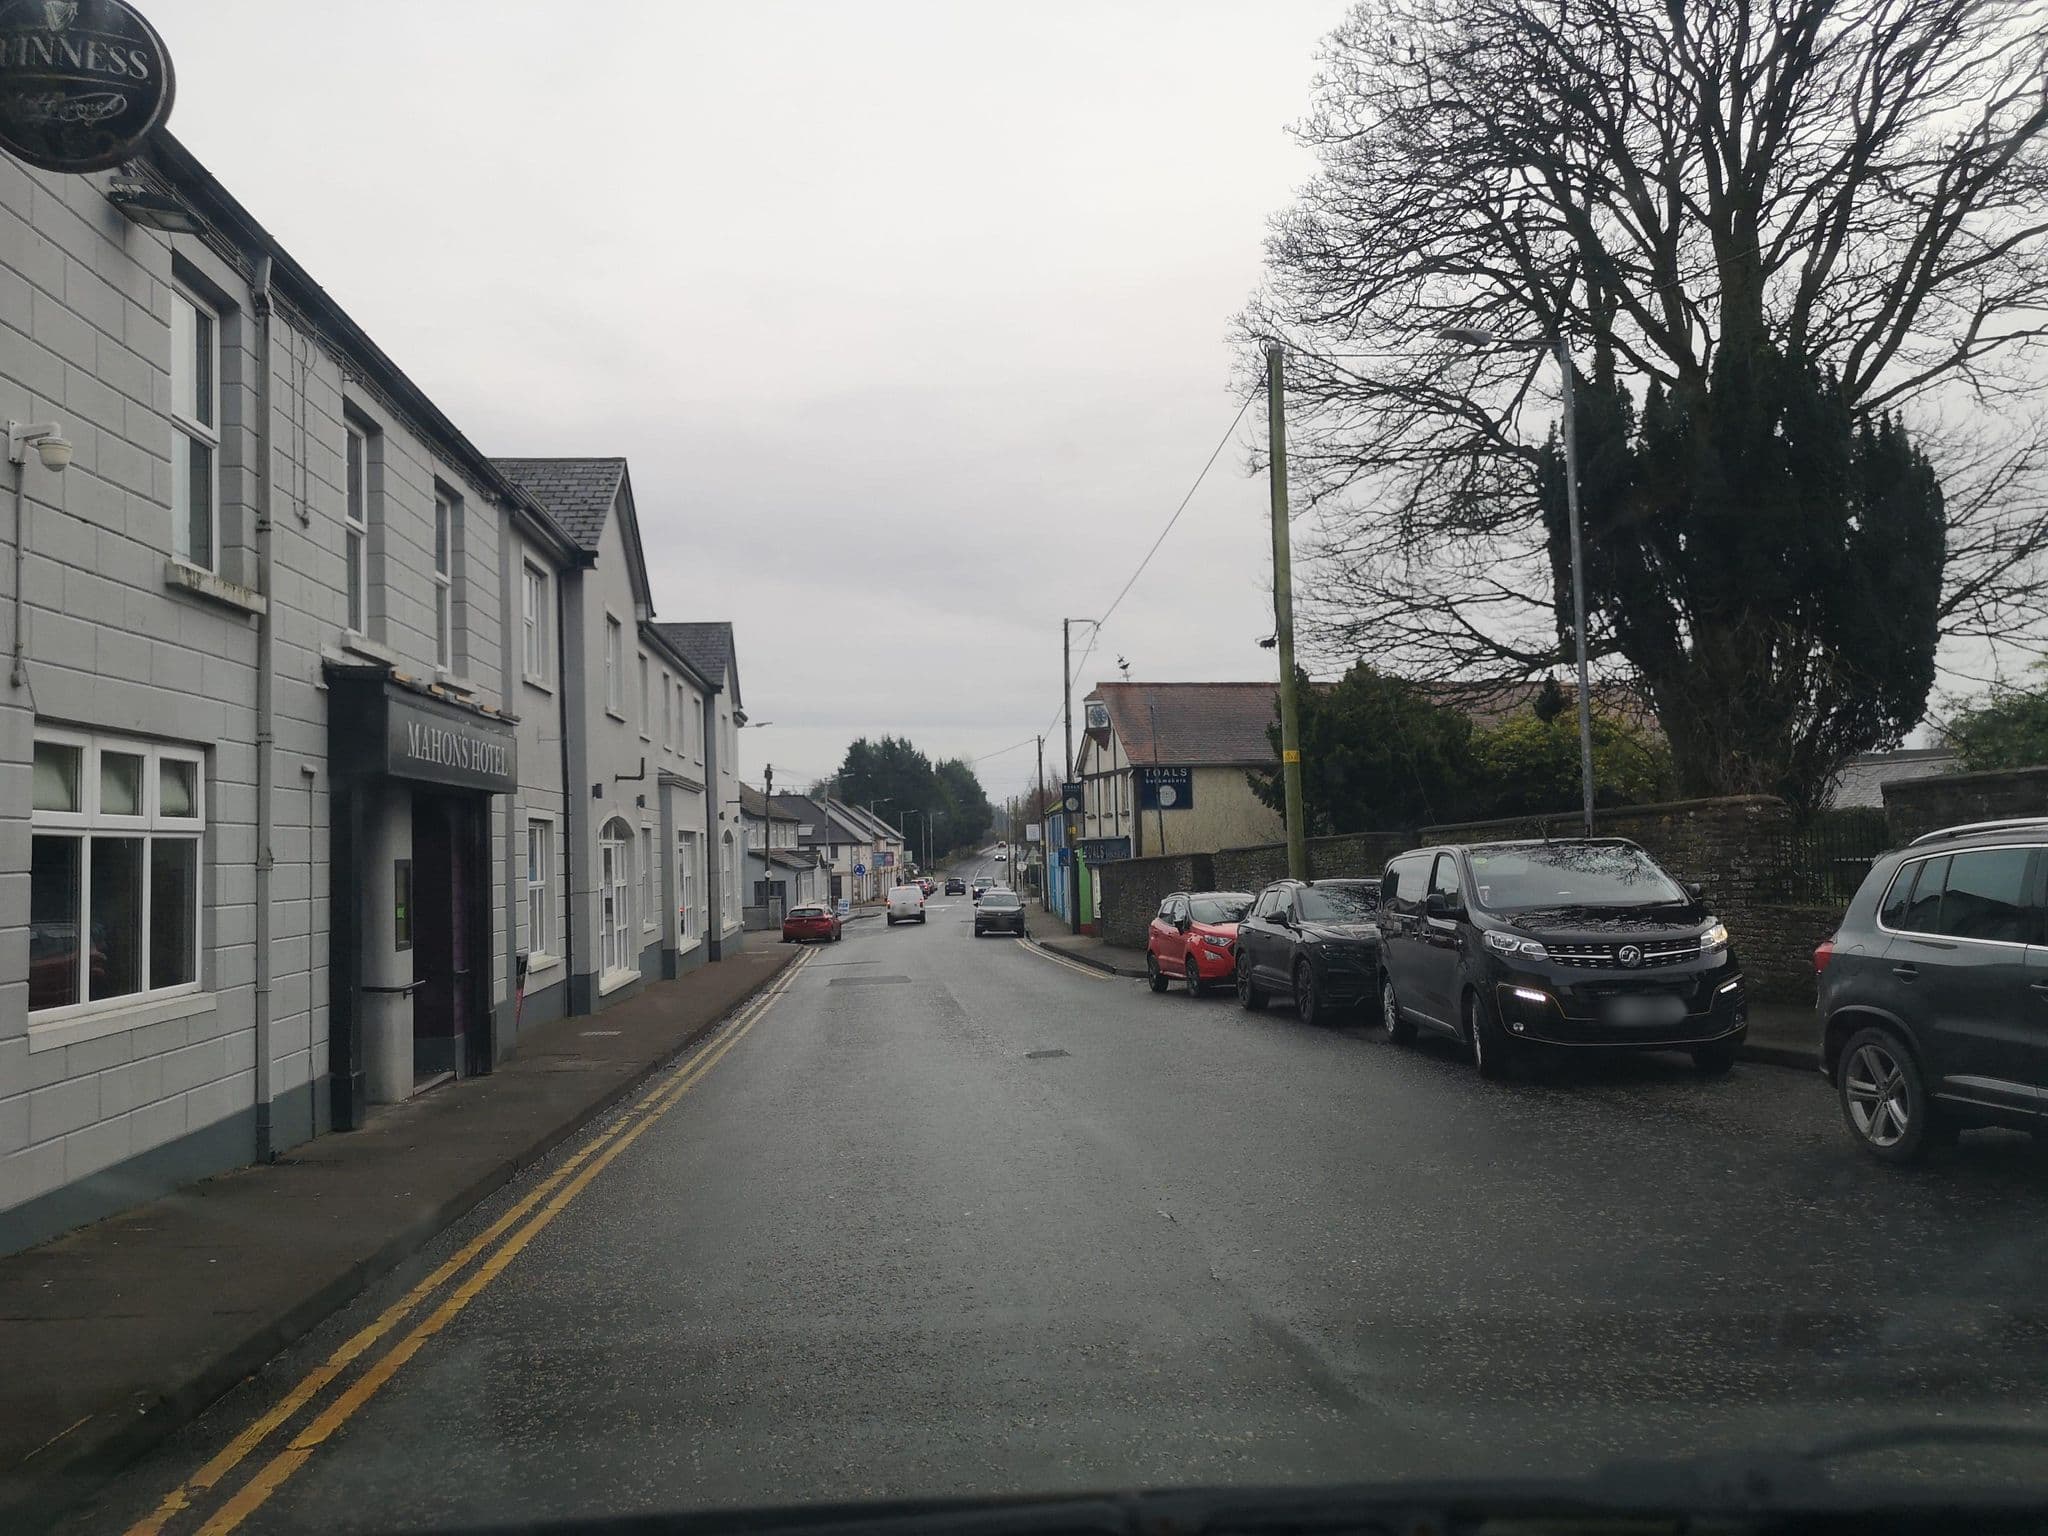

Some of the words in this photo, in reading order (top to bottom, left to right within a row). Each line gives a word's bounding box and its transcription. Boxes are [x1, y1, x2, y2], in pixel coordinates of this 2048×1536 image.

[407, 721, 468, 769] MAHON'S
[472, 740, 508, 776] HOTEL
[1144, 768, 1187, 777] TOALS
